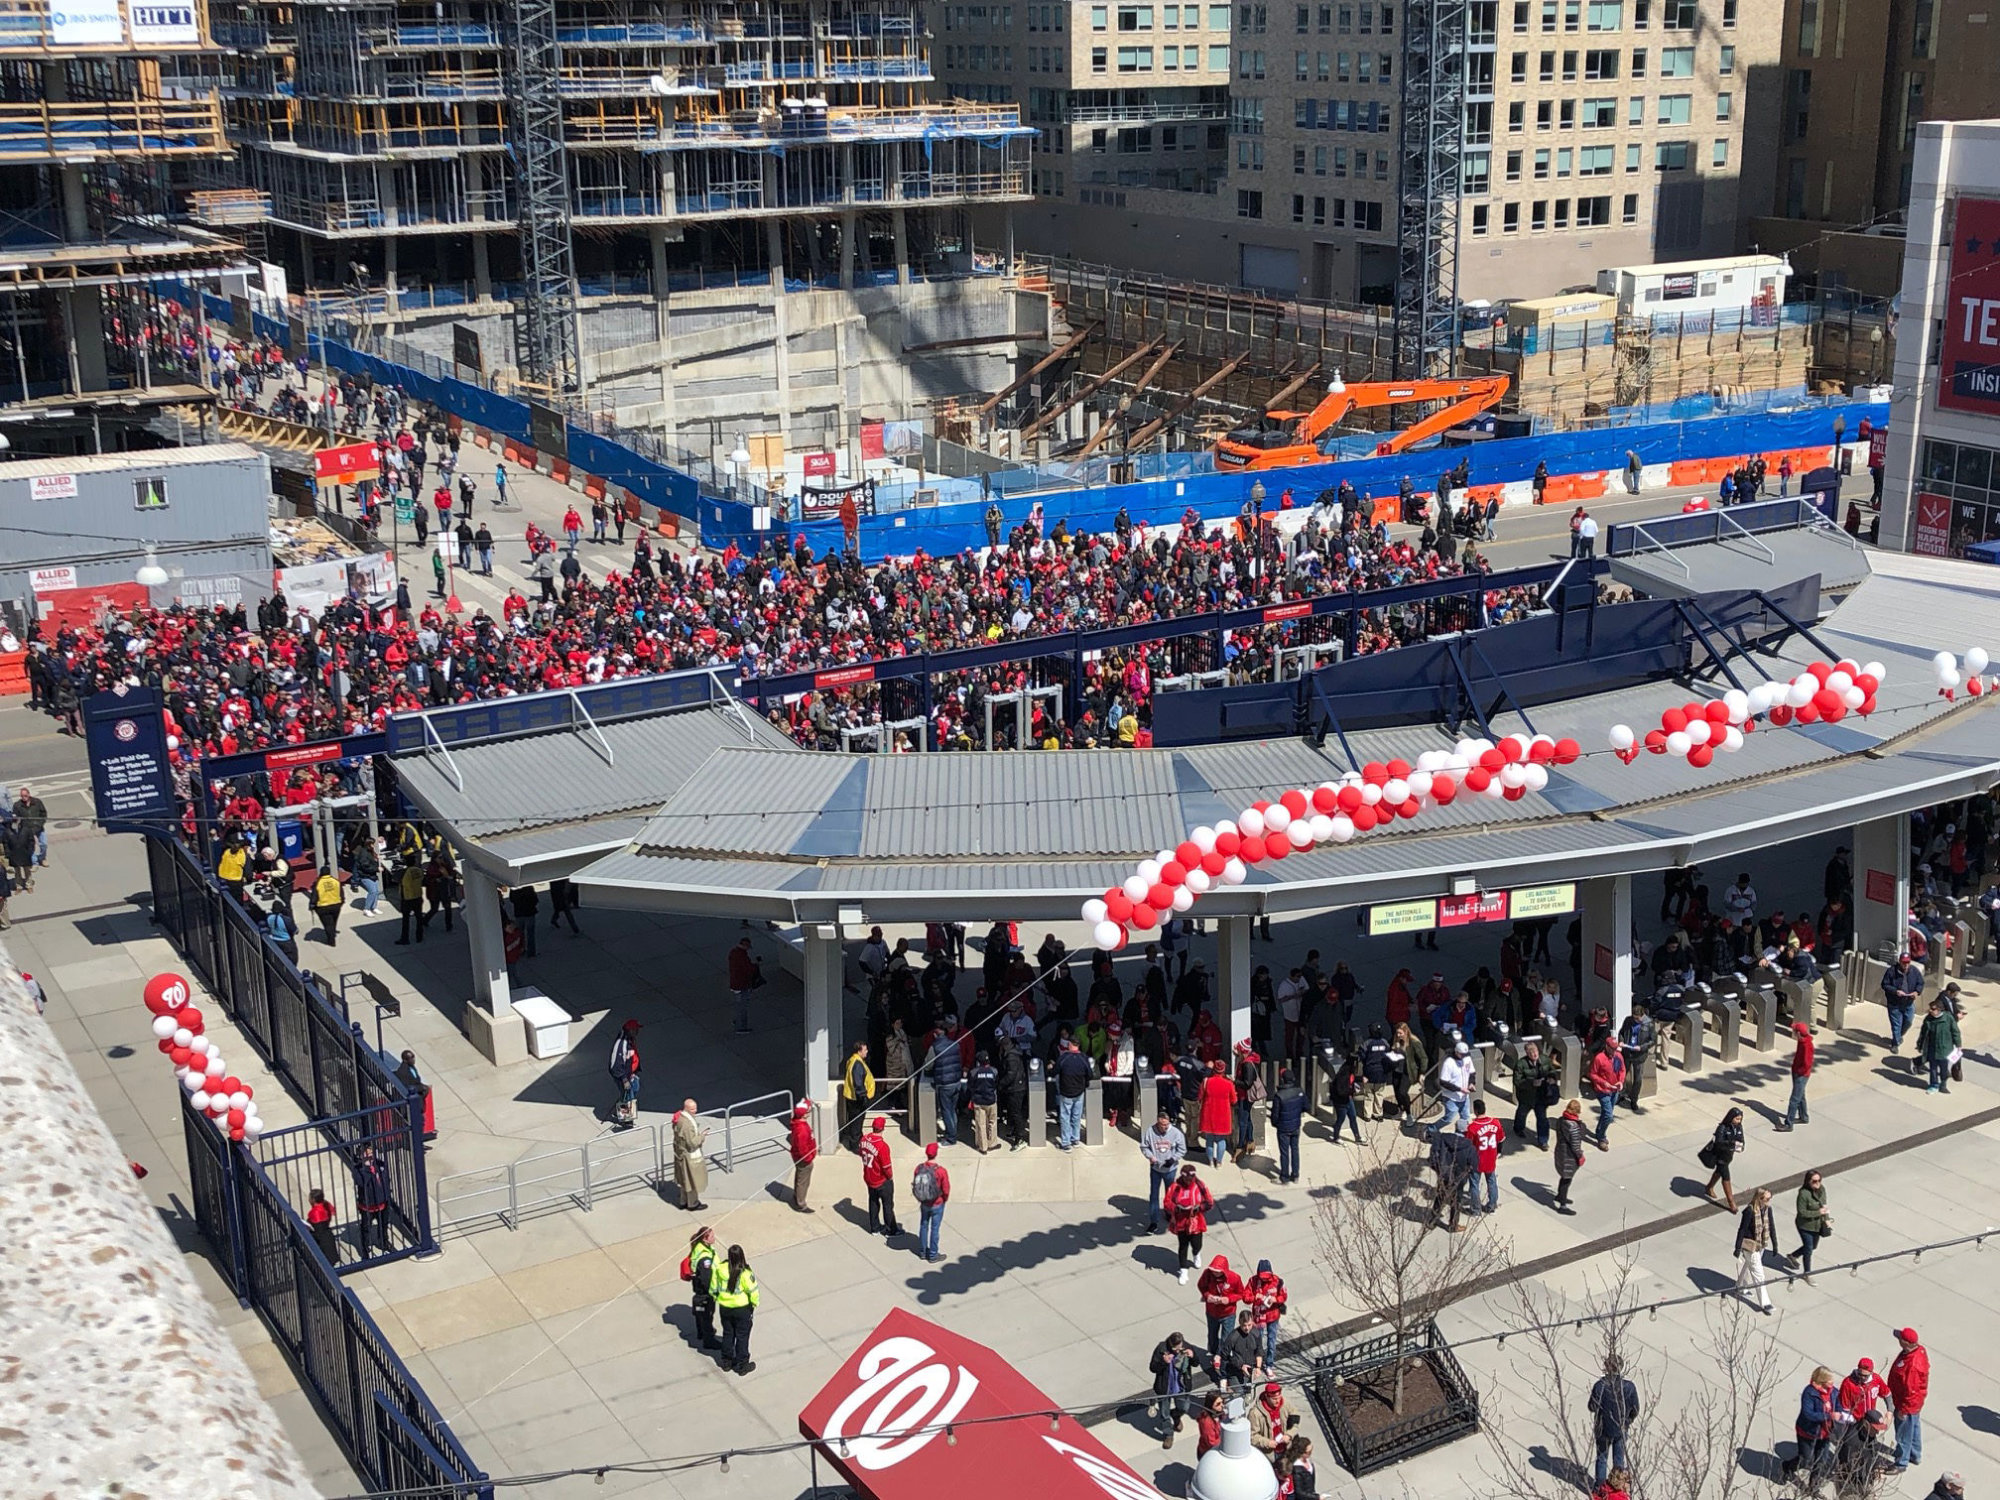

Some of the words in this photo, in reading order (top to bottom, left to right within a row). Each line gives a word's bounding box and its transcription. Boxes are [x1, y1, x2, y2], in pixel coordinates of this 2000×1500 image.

[135, 7, 192, 25] HITT
[1961, 297, 2000, 346] TE
[1971, 371, 2000, 395] INSI
[1872, 443, 1886, 455] CAL
[37, 476, 72, 487] ALLIED
[1962, 505, 1976, 519] WE
[1917, 532, 1947, 546] HAPPY
[1916, 540, 1946, 556] HOUR
[36, 568, 71, 580] ALLIED
[214, 577, 241, 593] STREET
[120, 755, 135, 763] Field
[112, 803, 127, 811] First
[1443, 905, 1456, 916] NO
[1458, 900, 1503, 915] RE-ENTRY
[1374, 918, 1390, 926] THANK
[1476, 1124, 1499, 1137] HARPER
[1479, 1133, 1497, 1150] 34
